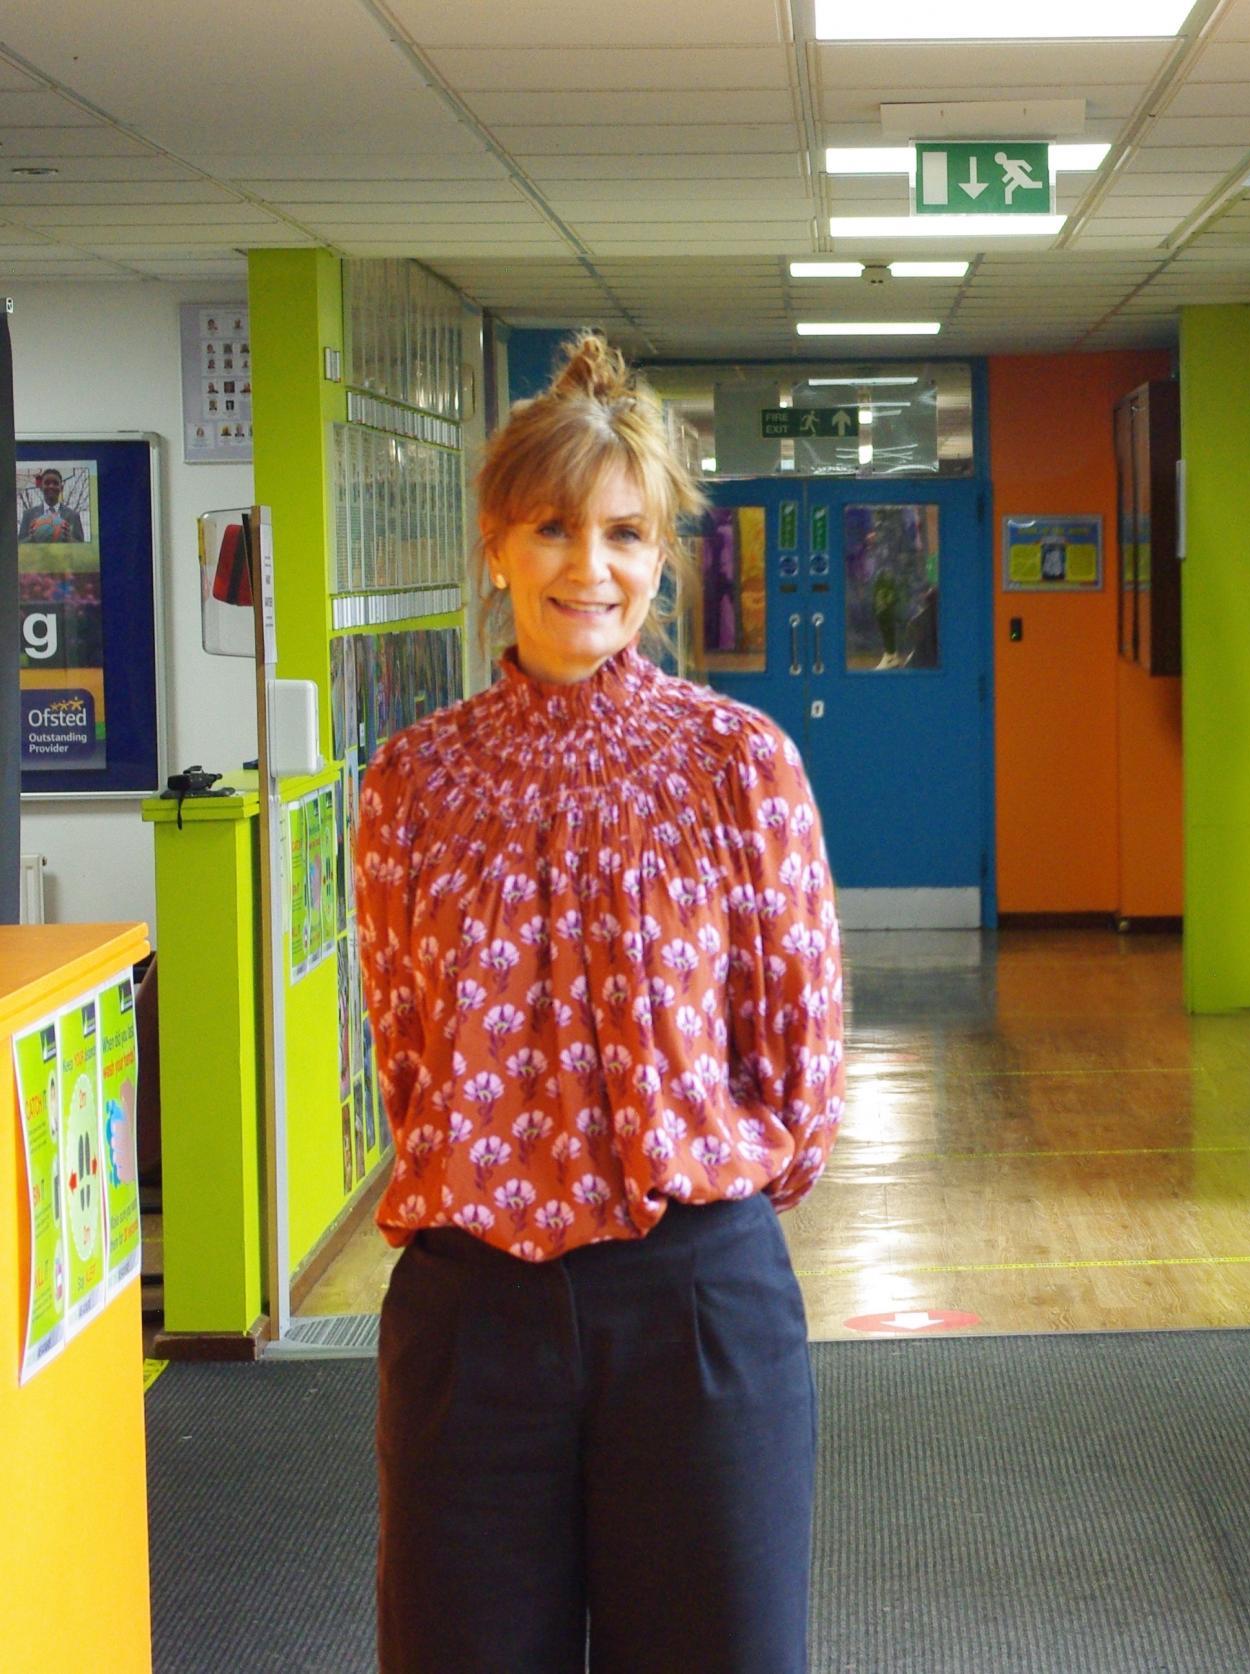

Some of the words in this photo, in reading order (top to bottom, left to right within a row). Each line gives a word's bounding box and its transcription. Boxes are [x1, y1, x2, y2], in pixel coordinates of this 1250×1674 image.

[765, 412, 789, 422] FIRE
[765, 424, 789, 434] EXIT
[28, 708, 87, 728] Ofsted
[28, 732, 88, 744] Outstanding
[28, 743, 70, 754] Provider
